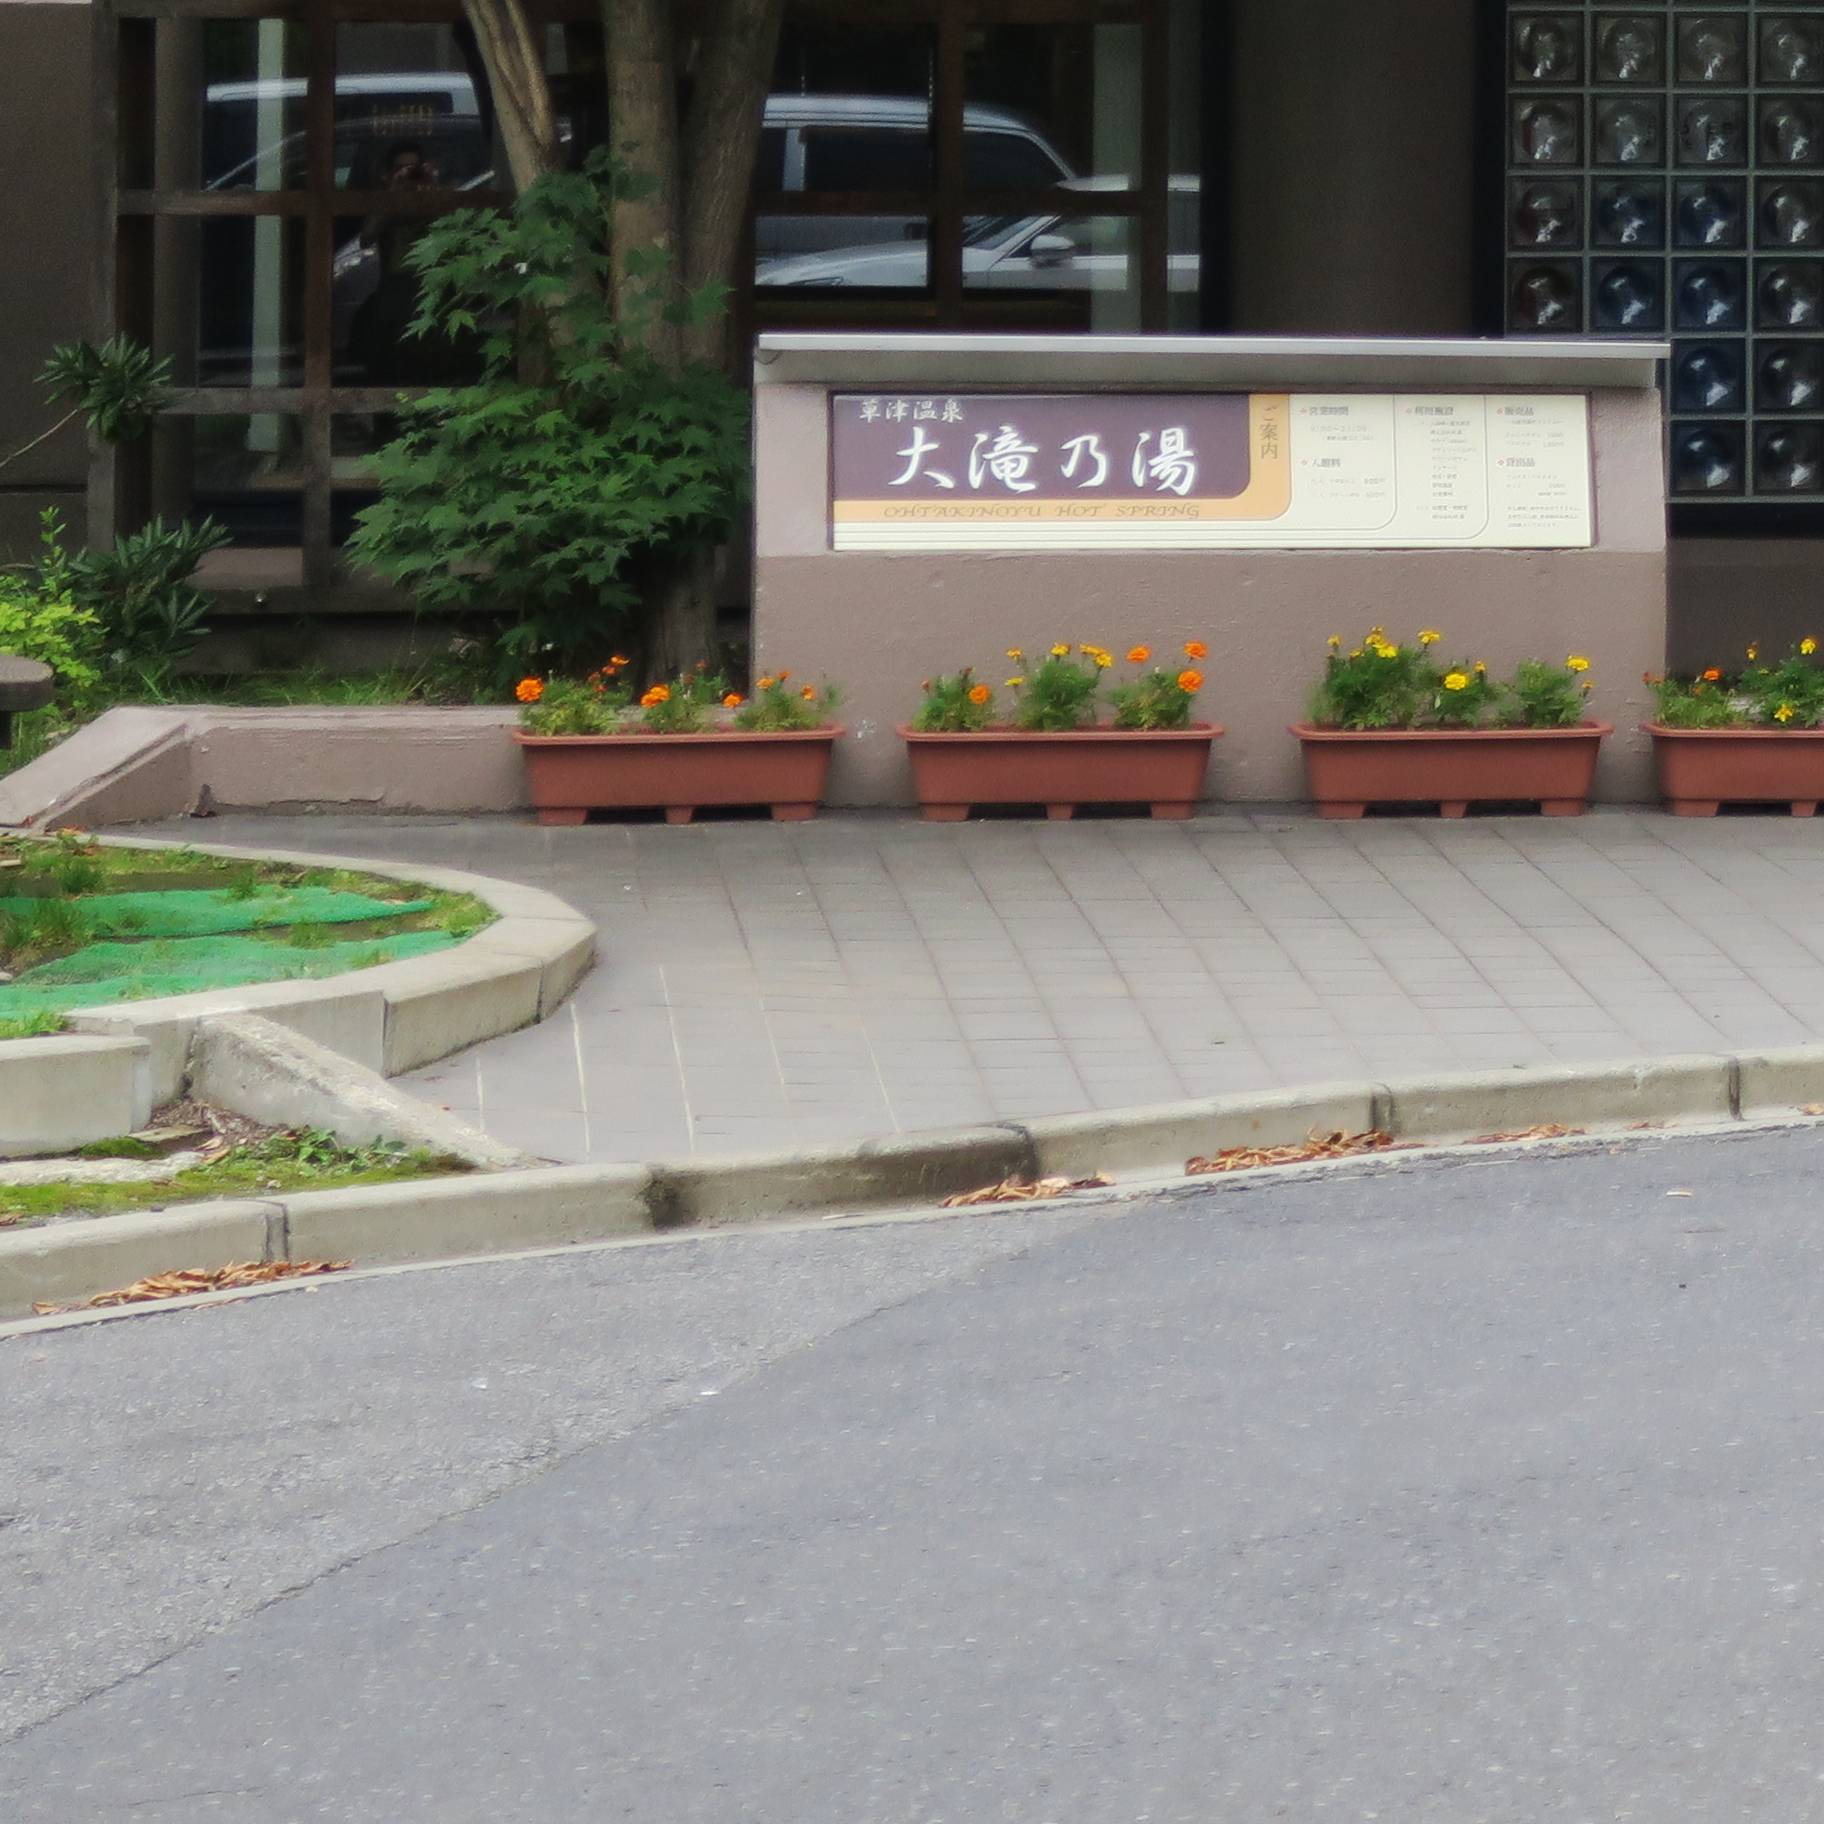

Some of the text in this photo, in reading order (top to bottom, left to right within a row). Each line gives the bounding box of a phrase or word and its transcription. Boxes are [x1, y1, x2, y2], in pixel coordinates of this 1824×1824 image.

[859, 398, 965, 424] 草津温泉
[1258, 405, 1281, 460] ご案内
[888, 425, 1198, 496] 大滝乃湯
[883, 504, 1200, 518] OHTAKINOYU HOT SPRING
